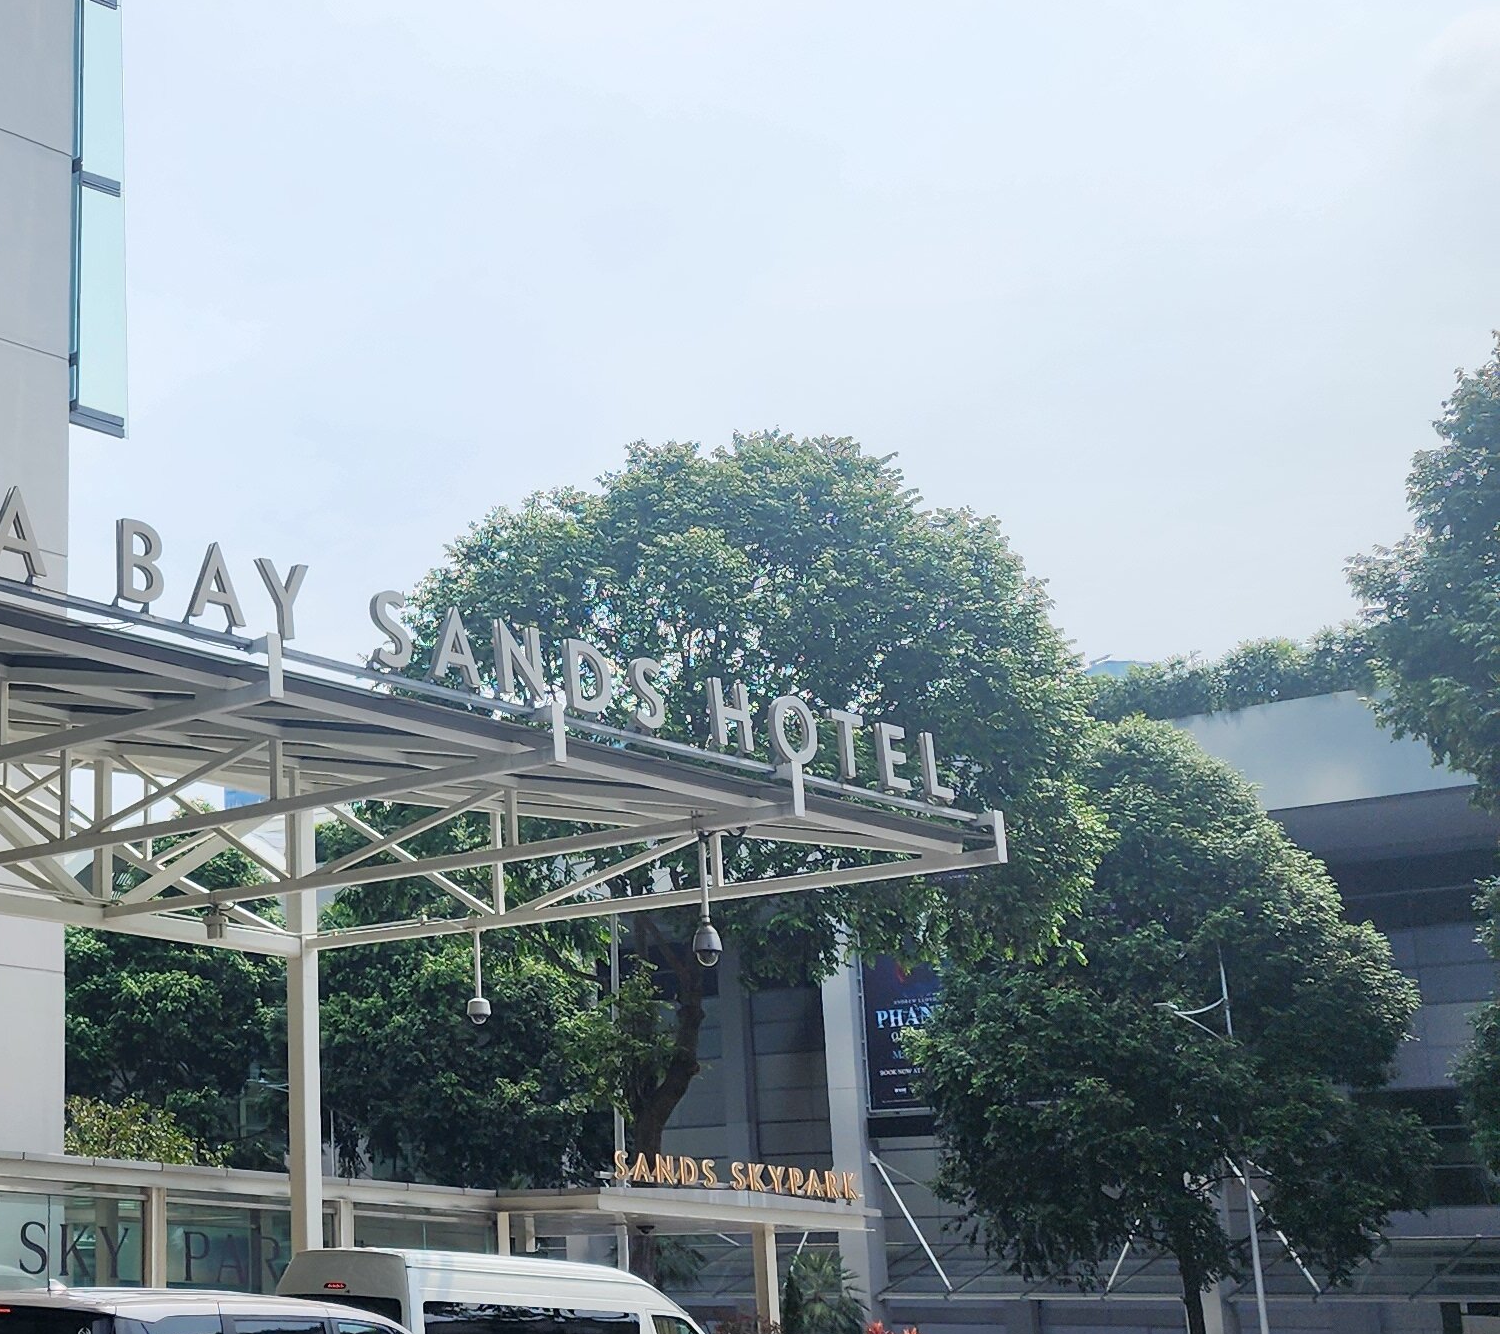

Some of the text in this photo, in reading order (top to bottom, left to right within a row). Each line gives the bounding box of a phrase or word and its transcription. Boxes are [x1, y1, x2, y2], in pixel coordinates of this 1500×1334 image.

[115, 517, 308, 641] BAY
[369, 589, 667, 731] SANDS
[705, 675, 956, 802] HOTEL
[614, 1150, 860, 1200] SANDS SKYPARK
[18, 1221, 129, 1279] SKY
